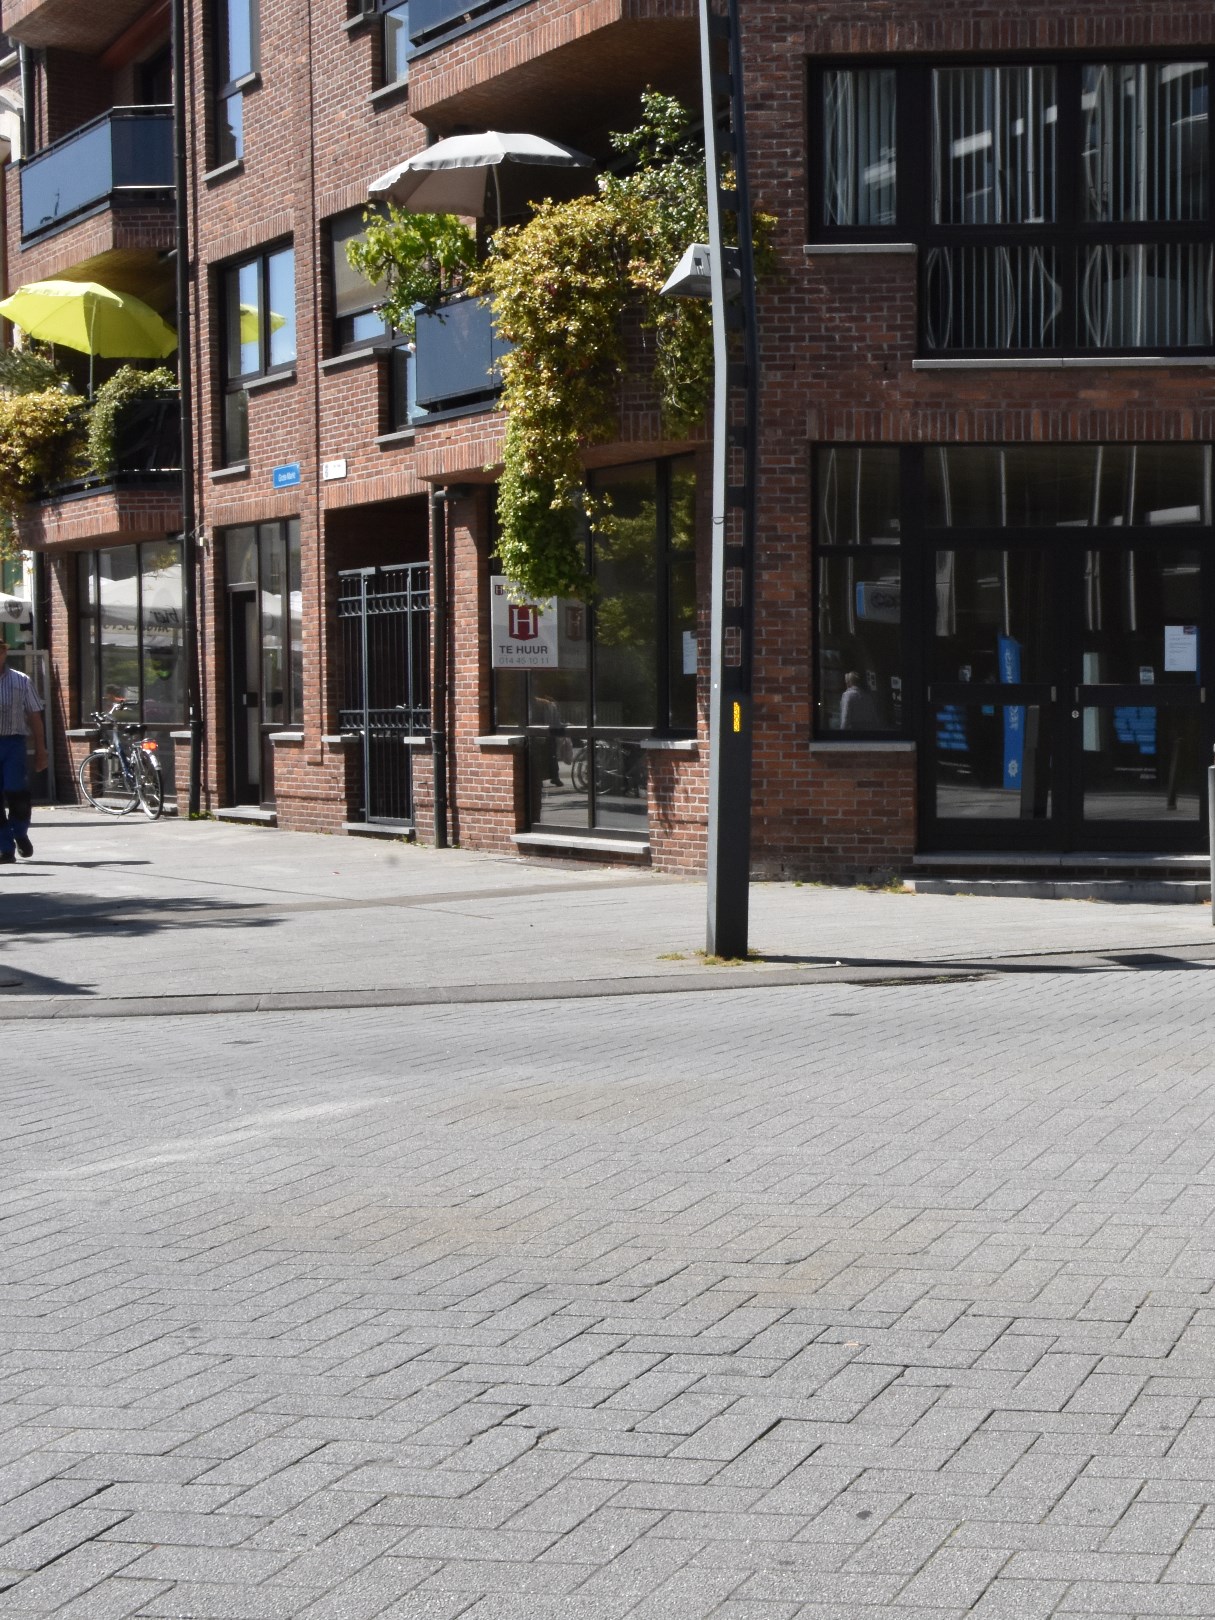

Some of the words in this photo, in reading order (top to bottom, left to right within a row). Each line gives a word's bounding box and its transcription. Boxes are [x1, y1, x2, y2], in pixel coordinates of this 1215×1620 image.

[499, 645, 512, 654] TE
[516, 645, 548, 655] HUUR
[499, 656, 513, 665] 014
[529, 656, 539, 665] 10
